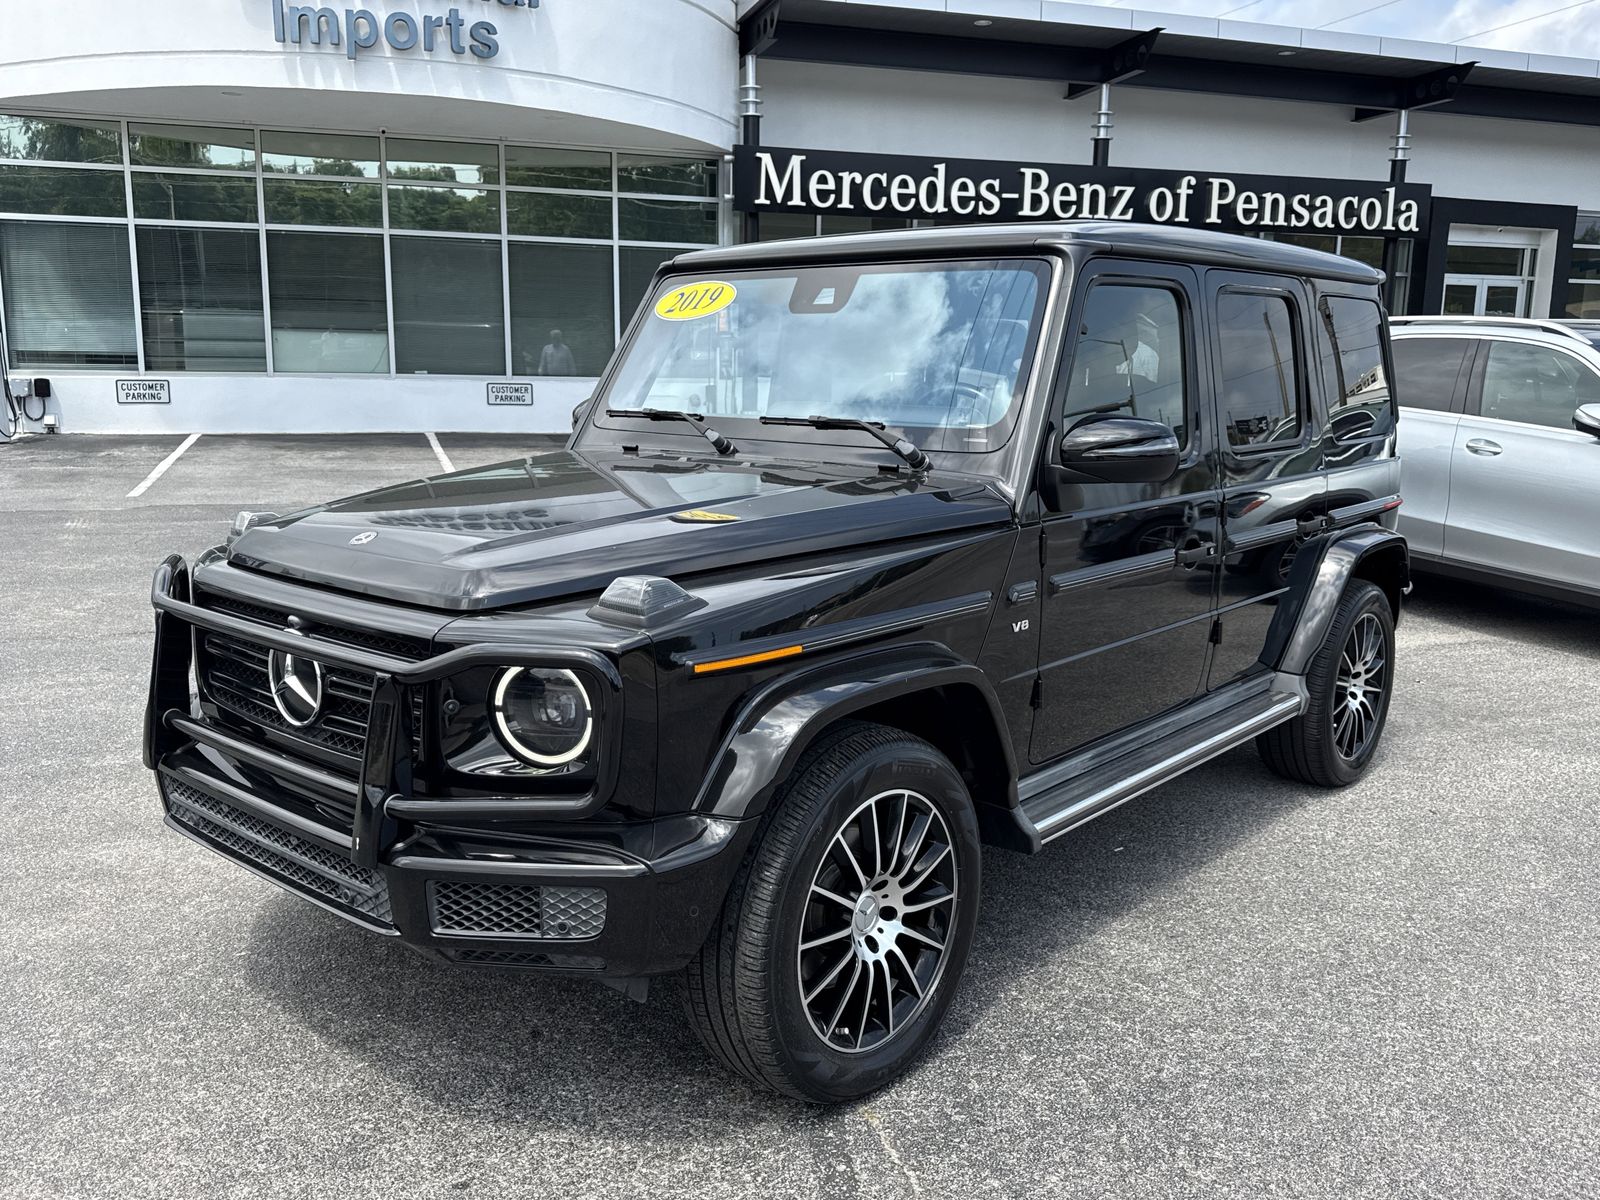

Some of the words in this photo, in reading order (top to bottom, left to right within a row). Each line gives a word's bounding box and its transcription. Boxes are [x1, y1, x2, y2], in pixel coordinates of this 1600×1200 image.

[272, 0, 499, 60] Imports
[754, 152, 1136, 220] Mercedes-Benz
[1149, 175, 1197, 222] of
[1205, 177, 1419, 232] Pensacola
[664, 285, 725, 314] 2019
[120, 382, 165, 392] CUSTOMER
[490, 385, 529, 394] CUSTOMER
[125, 392, 162, 401] PARKING
[494, 394, 526, 403] PARKING
[1012, 619, 1029, 633] V8
